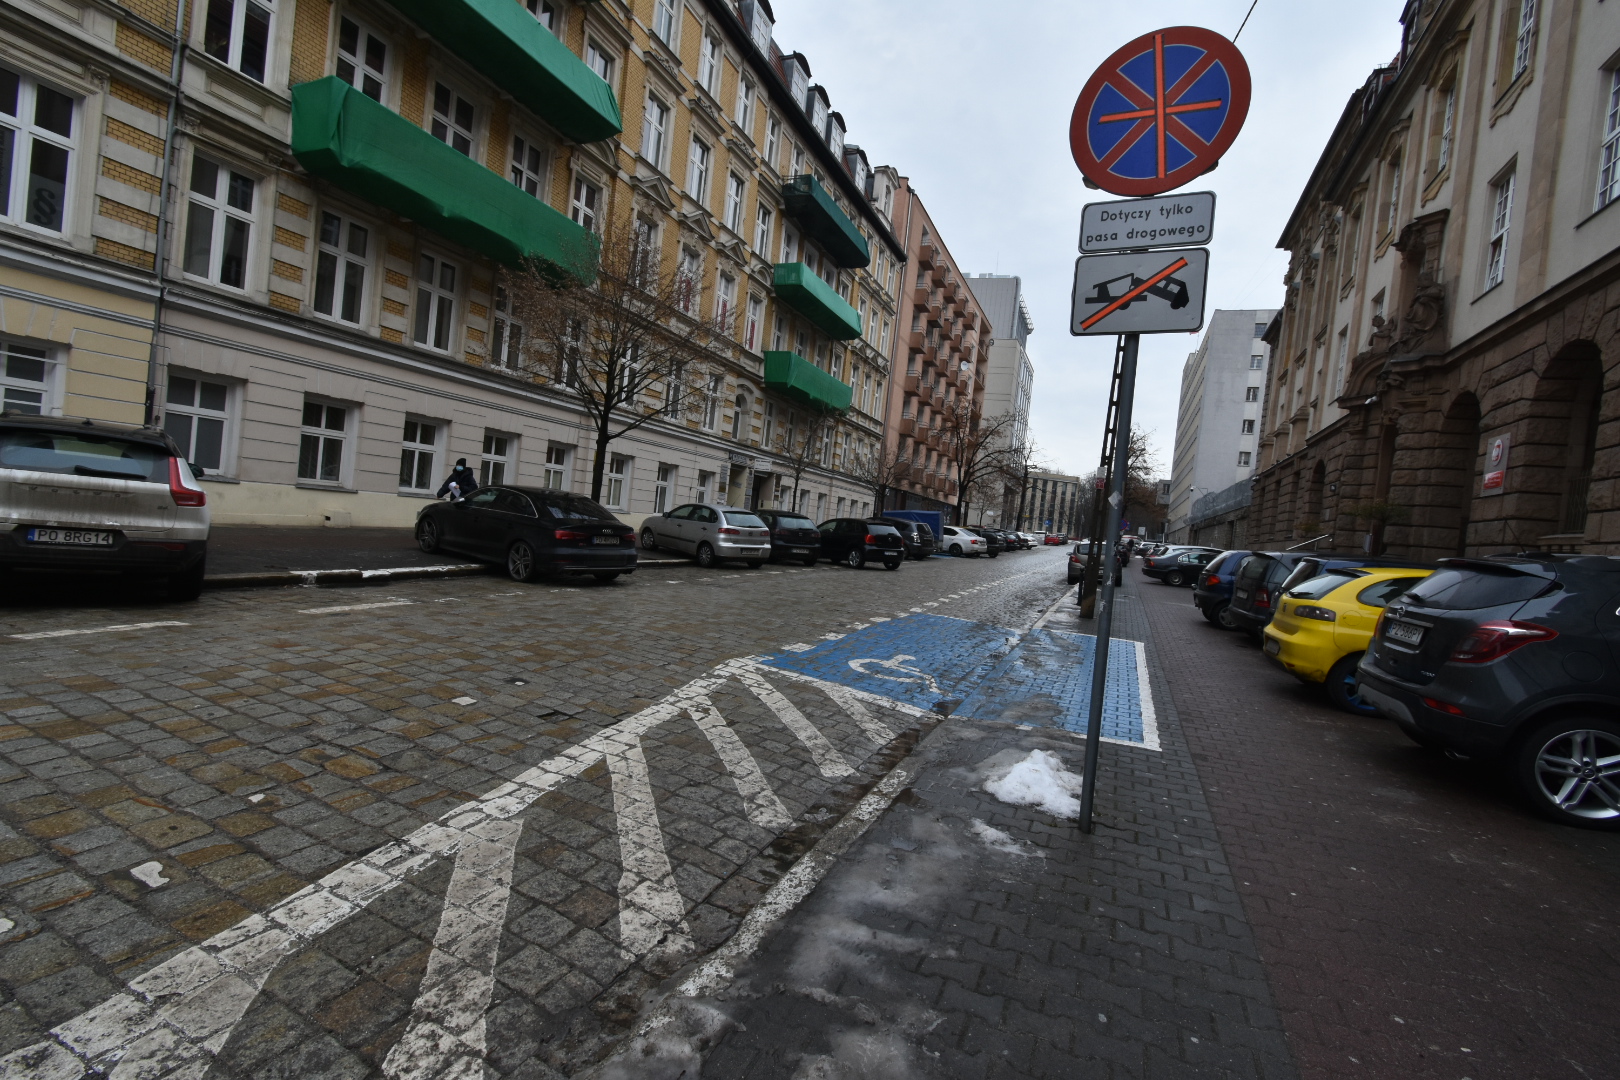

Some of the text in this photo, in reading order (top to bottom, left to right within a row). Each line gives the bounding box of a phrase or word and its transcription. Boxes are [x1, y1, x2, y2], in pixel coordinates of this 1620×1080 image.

[1100, 204, 1194, 223] Dotyczy tylko
[1086, 225, 1205, 246] pasa drogowego
[38, 529, 110, 544] PO 8RG14
